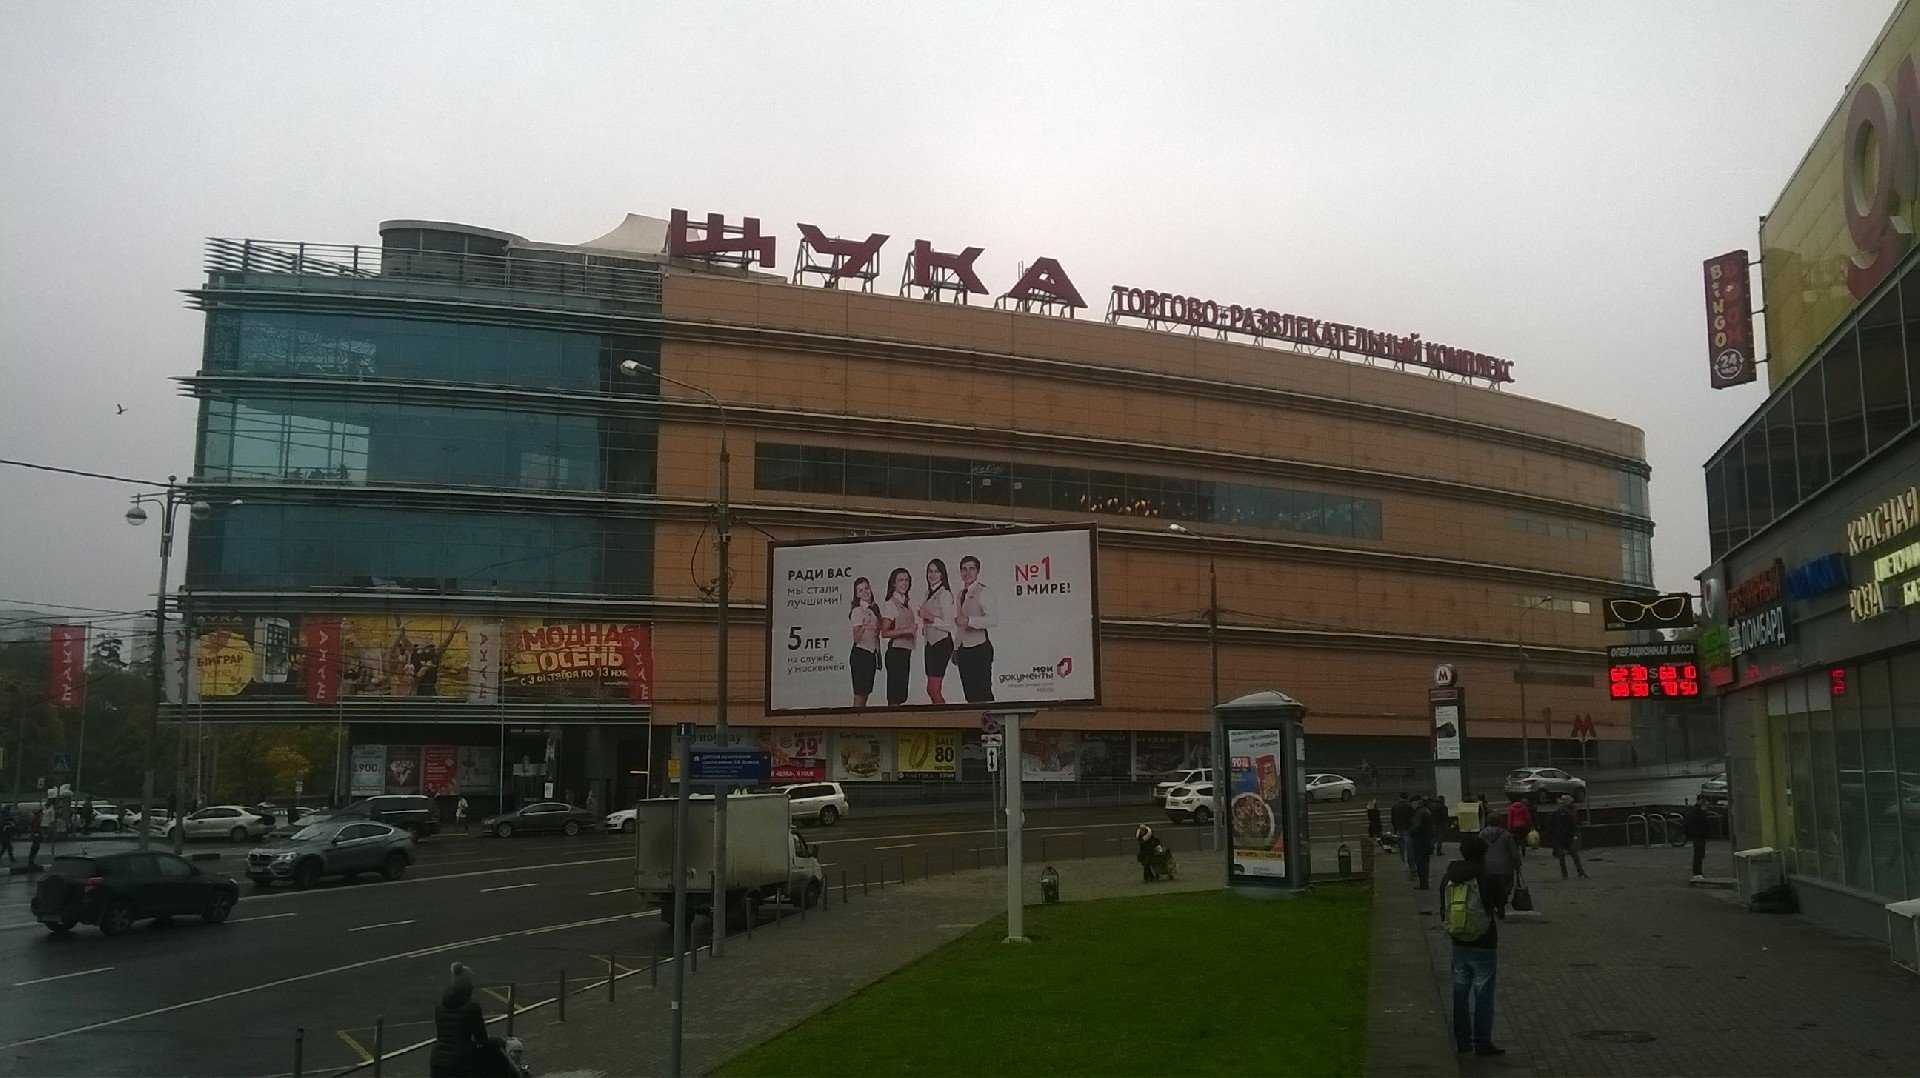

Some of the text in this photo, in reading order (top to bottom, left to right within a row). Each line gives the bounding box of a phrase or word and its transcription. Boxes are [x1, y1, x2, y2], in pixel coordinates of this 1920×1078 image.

[670, 208, 1088, 309] ЩУКА
[1112, 285, 1516, 384] ТОРГОВО-РАЗВЛЕКАТЕЛЬНЫЙ КОМПЛЕКС
[1847, 486, 1919, 557] КРАСНАЯ
[788, 567, 852, 581] РАДИ ВАС
[1015, 556, 1050, 581] №1
[787, 586, 839, 597] мы стали
[1016, 582, 1071, 596] В МИРЕ!
[787, 594, 843, 609] лучшими!
[1848, 579, 1885, 623] РОЗА
[1741, 606, 1786, 652] ЛОМБАРД
[788, 626, 830, 650] 5 ЛЕТ
[539, 647, 624, 671] ОСЕНЬ
[1611, 644, 1695, 658] ОПЕРАЦИОННАЯ КАССА
[795, 662, 845, 673] москвичей
[800, 654, 834, 665] службе
[999, 672, 1054, 684] документы
[934, 747, 954, 763] 80
